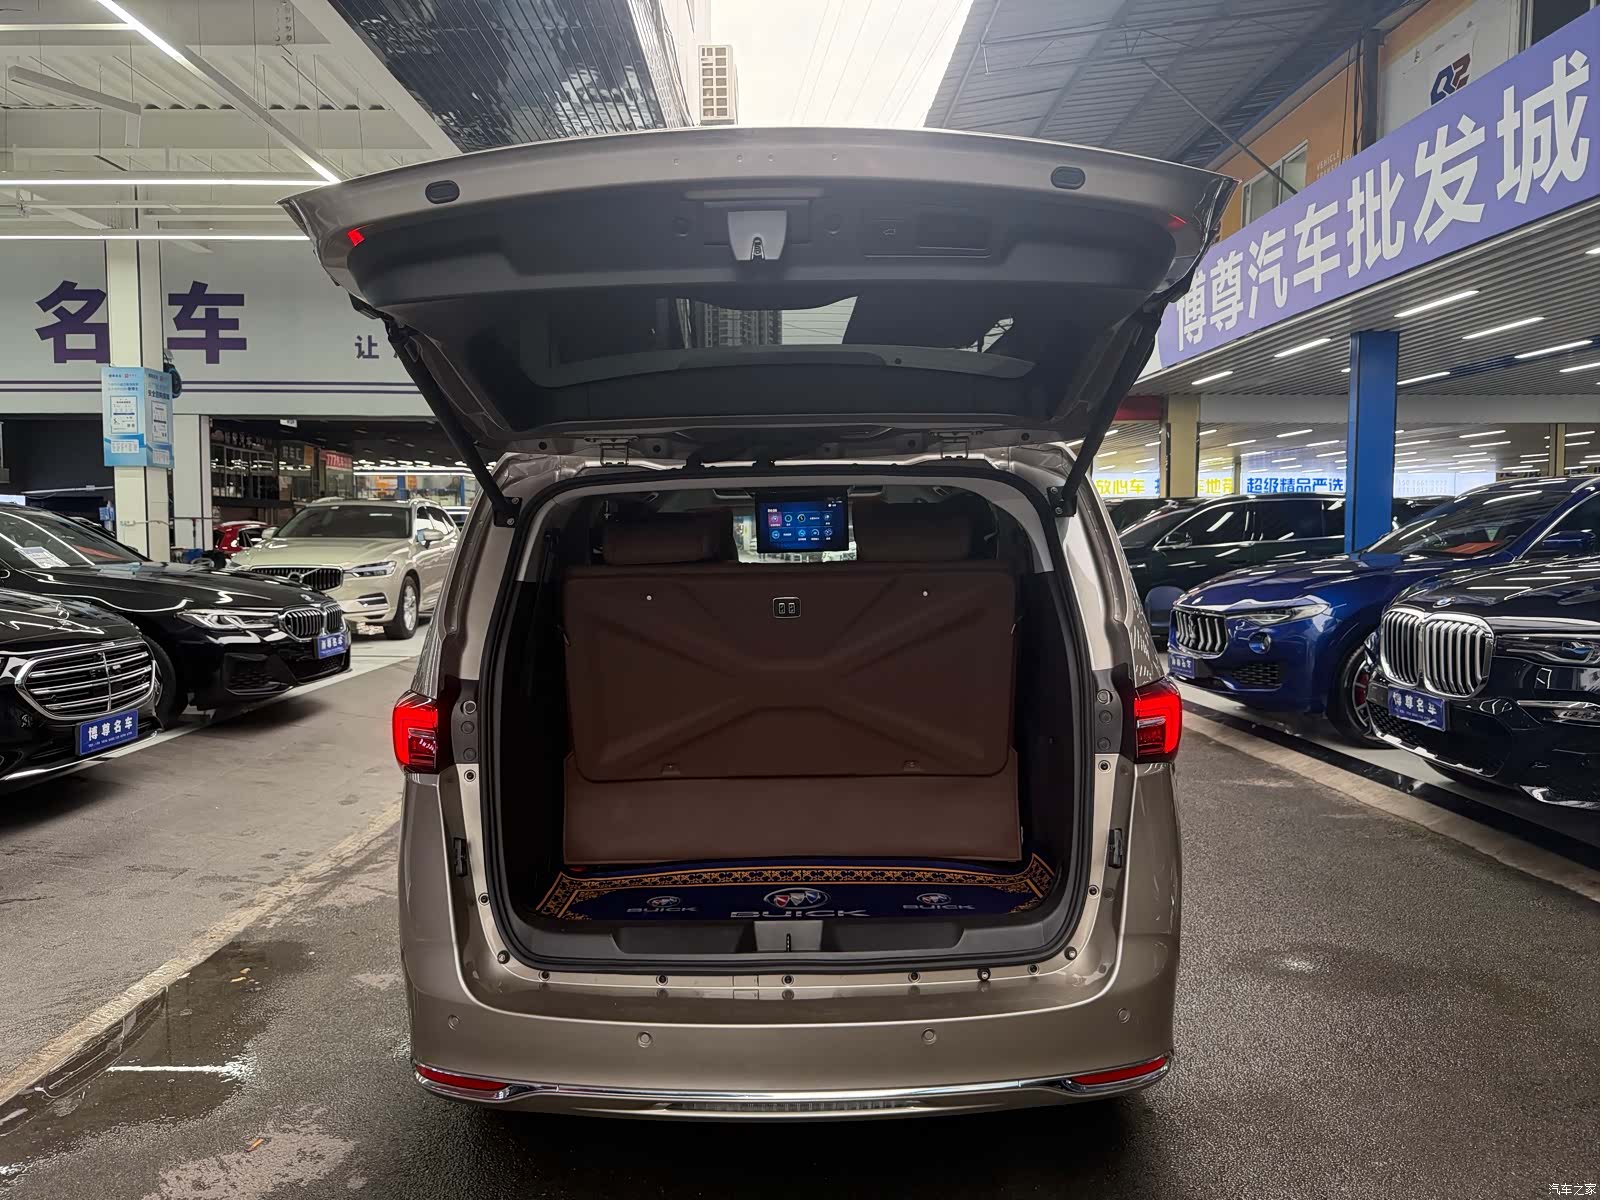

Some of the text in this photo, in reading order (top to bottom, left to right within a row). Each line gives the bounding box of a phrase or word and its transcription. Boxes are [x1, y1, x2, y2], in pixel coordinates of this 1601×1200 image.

[1177, 50, 1591, 352] 博尊汽车批发城
[1096, 478, 1145, 494] 放心车
[1247, 477, 1344, 494] 超级精品严选
[88, 716, 133, 742] 博尊名车
[730, 909, 871, 918] BUICK
